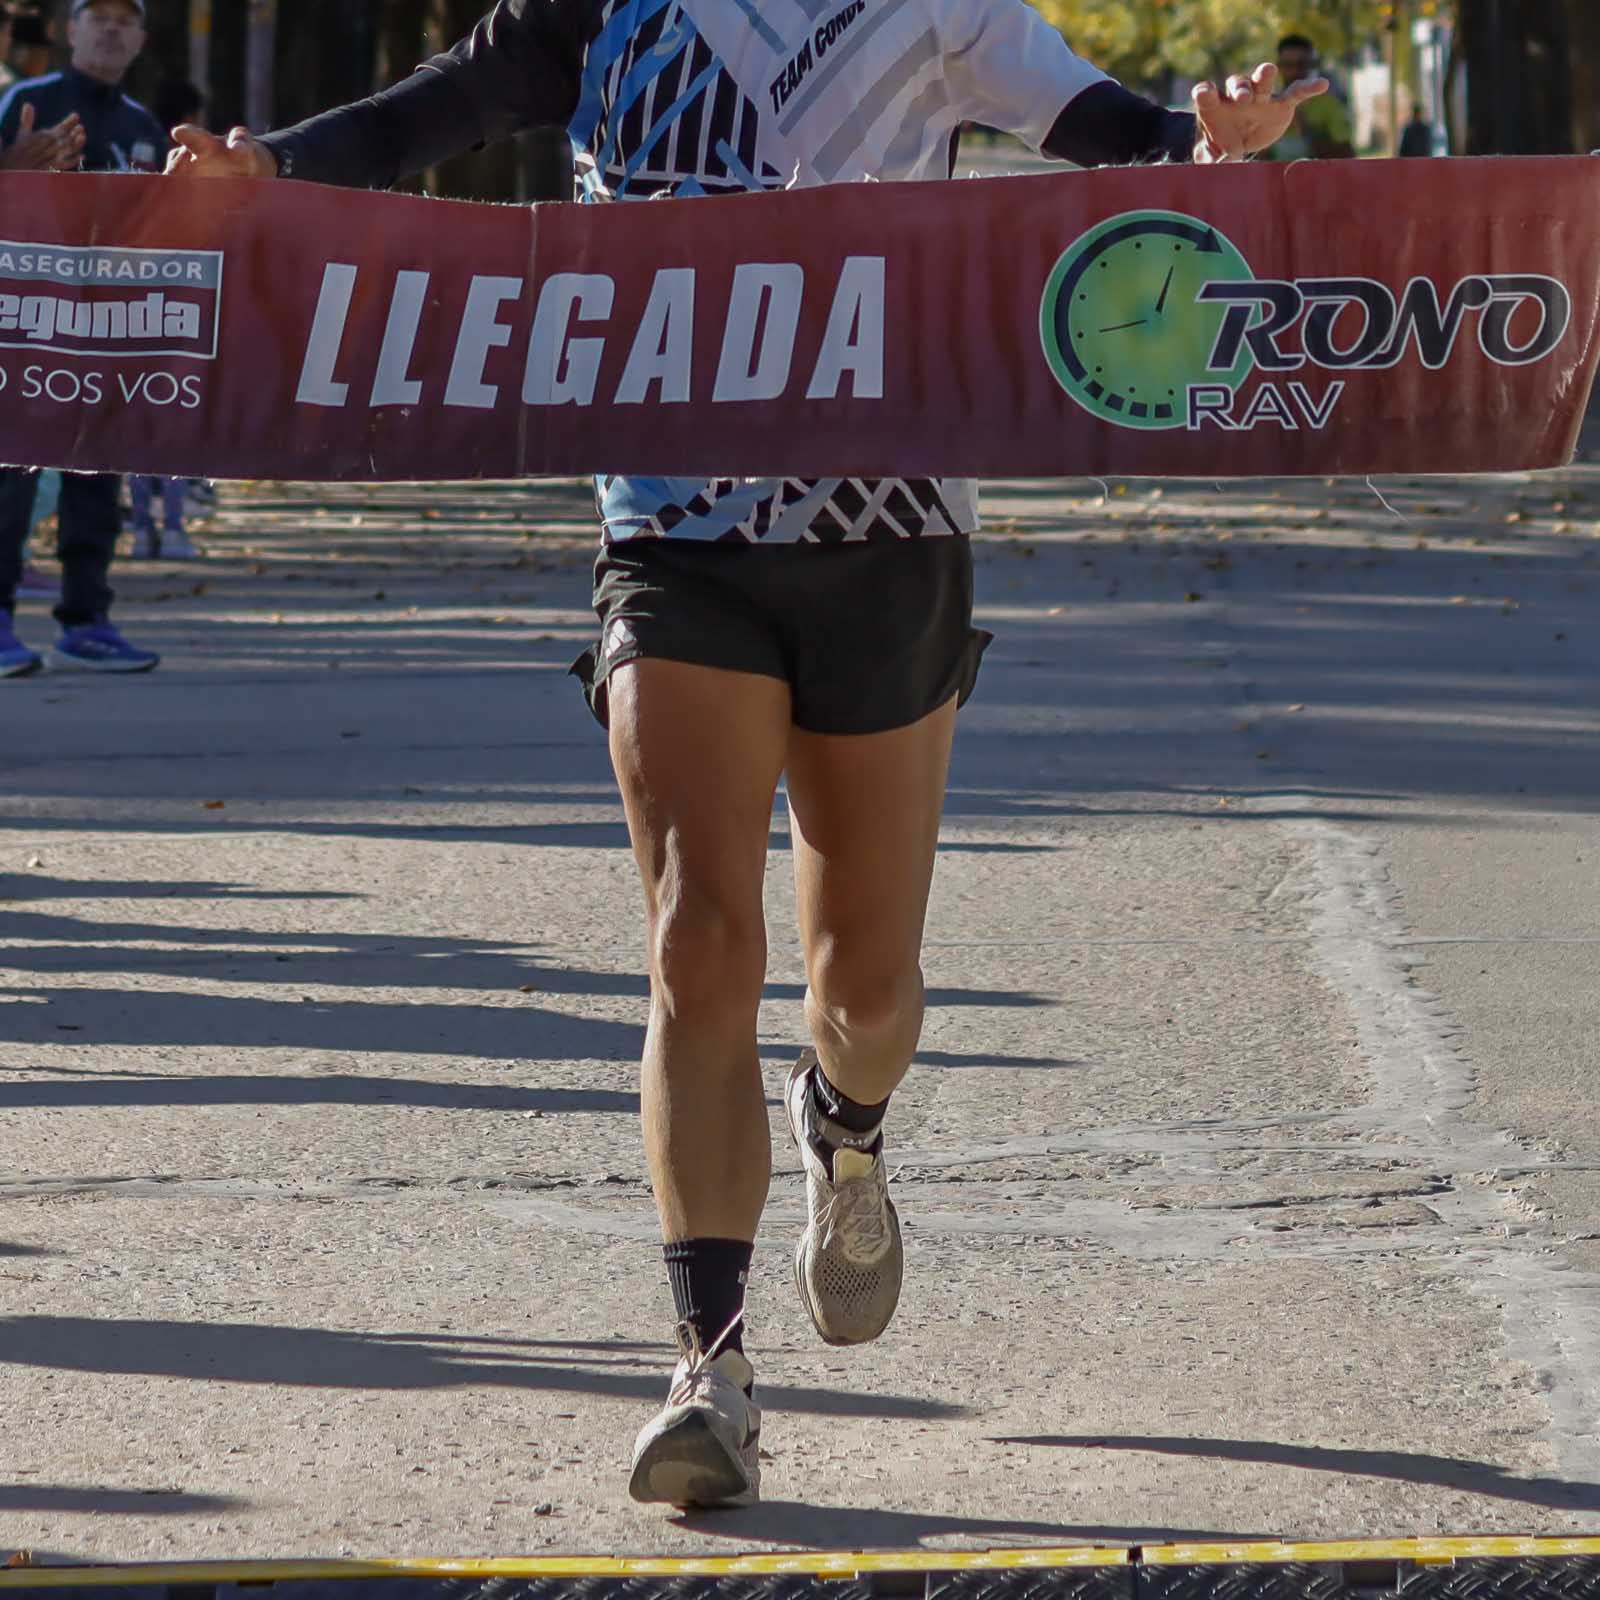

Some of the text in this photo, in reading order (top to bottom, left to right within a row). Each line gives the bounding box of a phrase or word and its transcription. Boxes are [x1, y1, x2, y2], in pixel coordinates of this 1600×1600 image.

[769, 37, 813, 115] TEAM
[295, 255, 886, 409] LLEGADA
[22, 366, 103, 404] SOS
[117, 372, 202, 409] VOS
[1185, 380, 1345, 431] RAV
